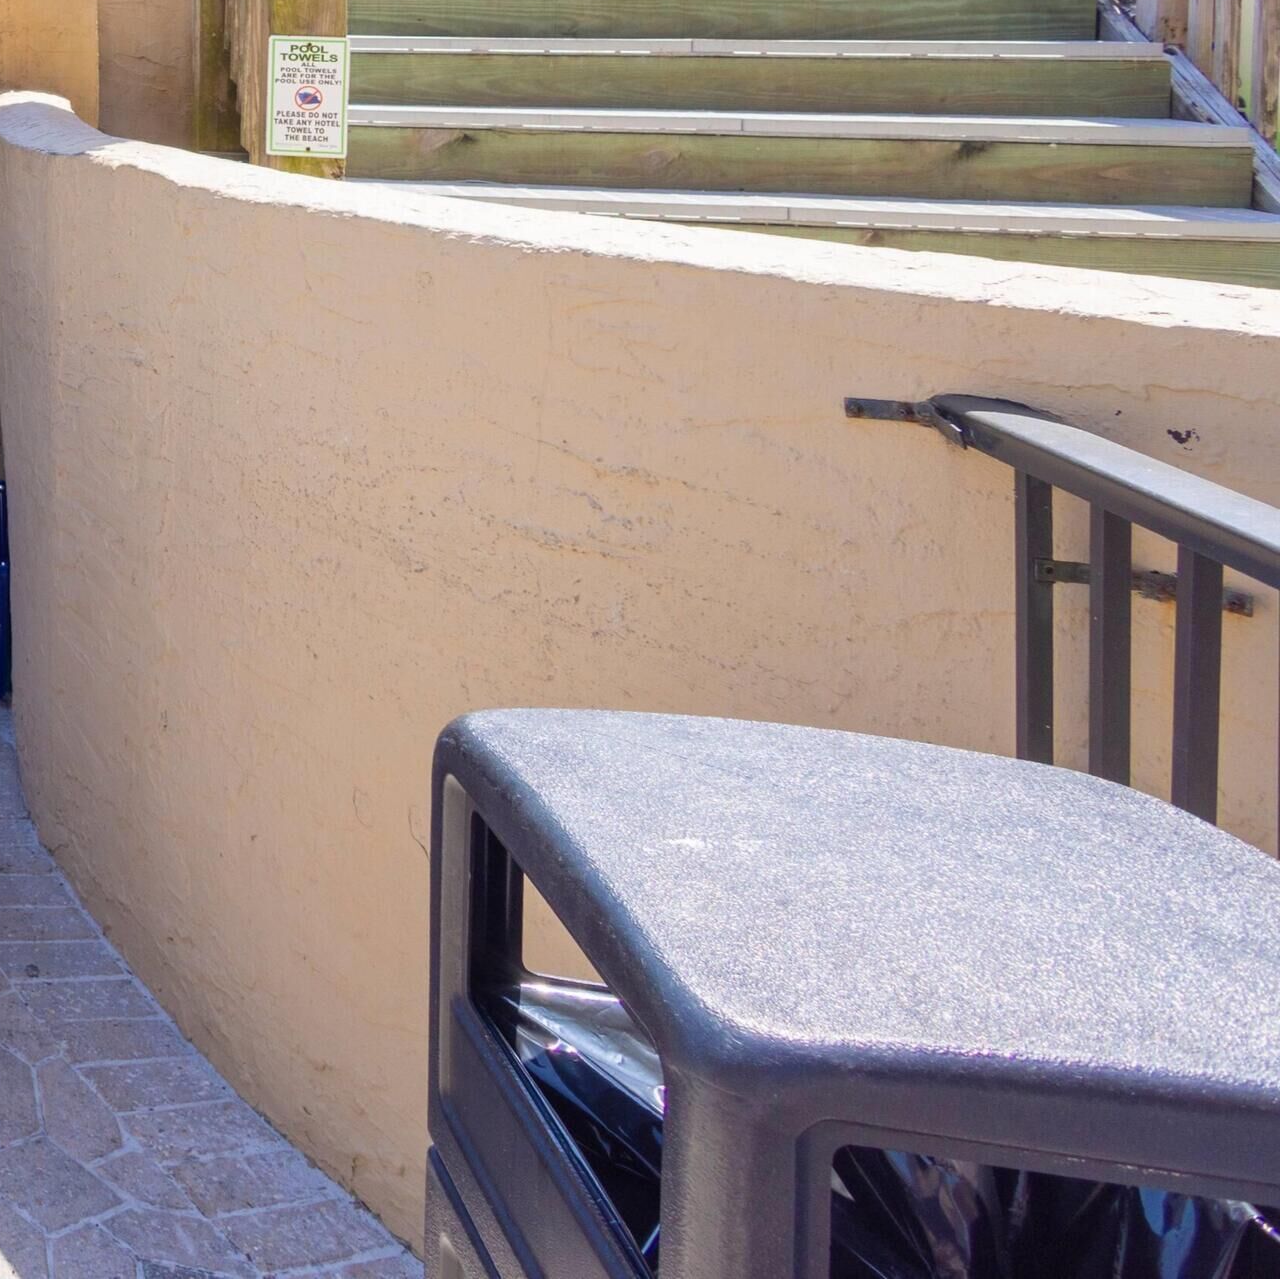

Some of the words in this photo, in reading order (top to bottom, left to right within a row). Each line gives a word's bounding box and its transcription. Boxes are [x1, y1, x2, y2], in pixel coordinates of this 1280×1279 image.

[290, 44, 328, 54] POOL
[280, 52, 338, 63] TOWELS
[276, 110, 306, 118] PLEASE
